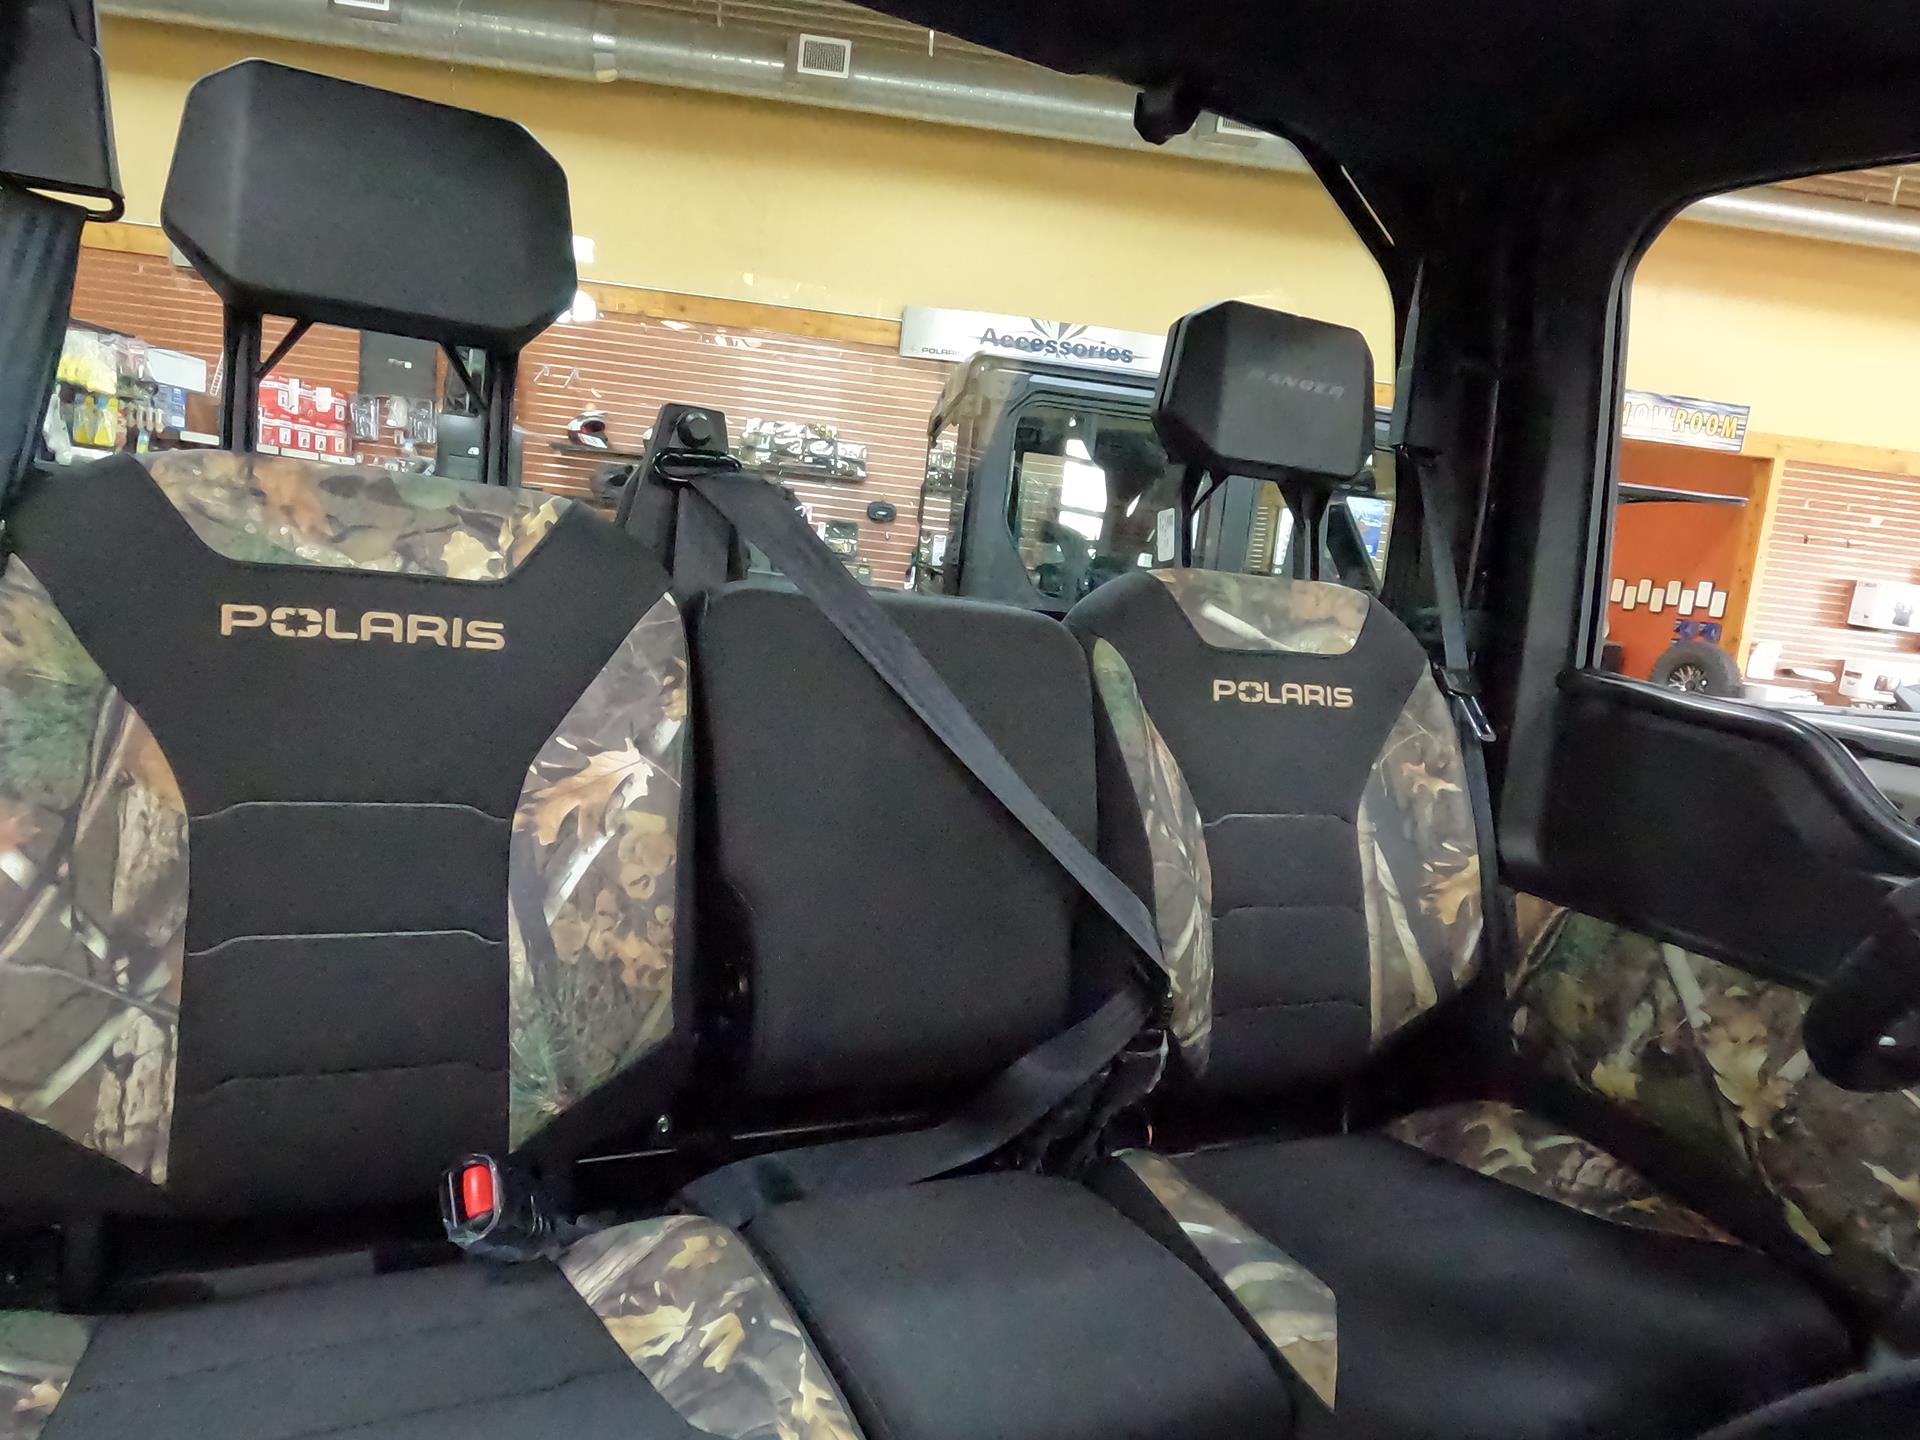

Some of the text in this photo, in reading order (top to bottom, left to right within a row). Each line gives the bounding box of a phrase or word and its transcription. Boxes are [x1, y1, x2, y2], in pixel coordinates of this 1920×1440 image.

[921, 347, 963, 357] POLARI
[980, 327, 1134, 364] Accessories
[220, 603, 506, 650] POLARIS
[1213, 679, 1354, 708] POLARIS
